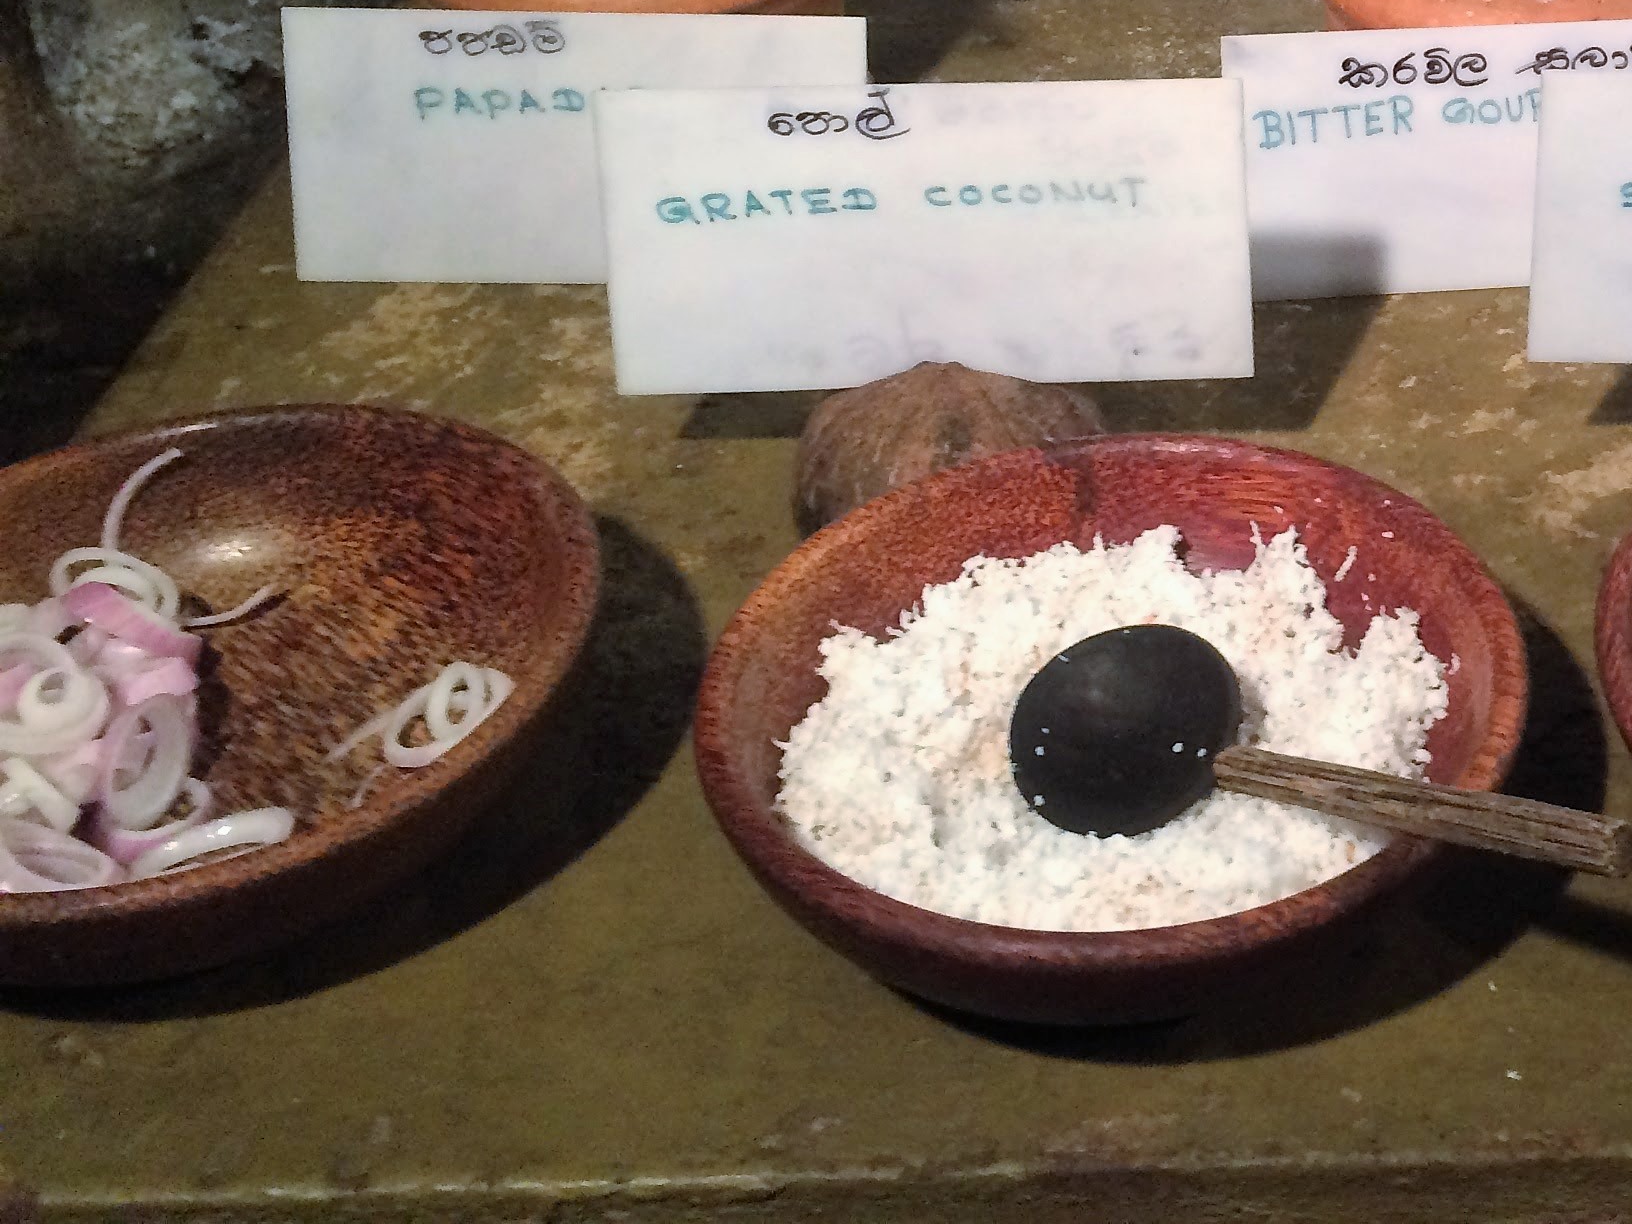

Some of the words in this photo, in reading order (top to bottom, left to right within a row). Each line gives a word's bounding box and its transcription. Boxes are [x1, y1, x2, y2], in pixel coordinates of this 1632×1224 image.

[413, 86, 586, 121] PAPAD
[767, 87, 911, 140] පොල්
[1252, 94, 1415, 150] BITTER
[655, 186, 879, 225] GRATED
[923, 177, 1147, 209] COCONUT
